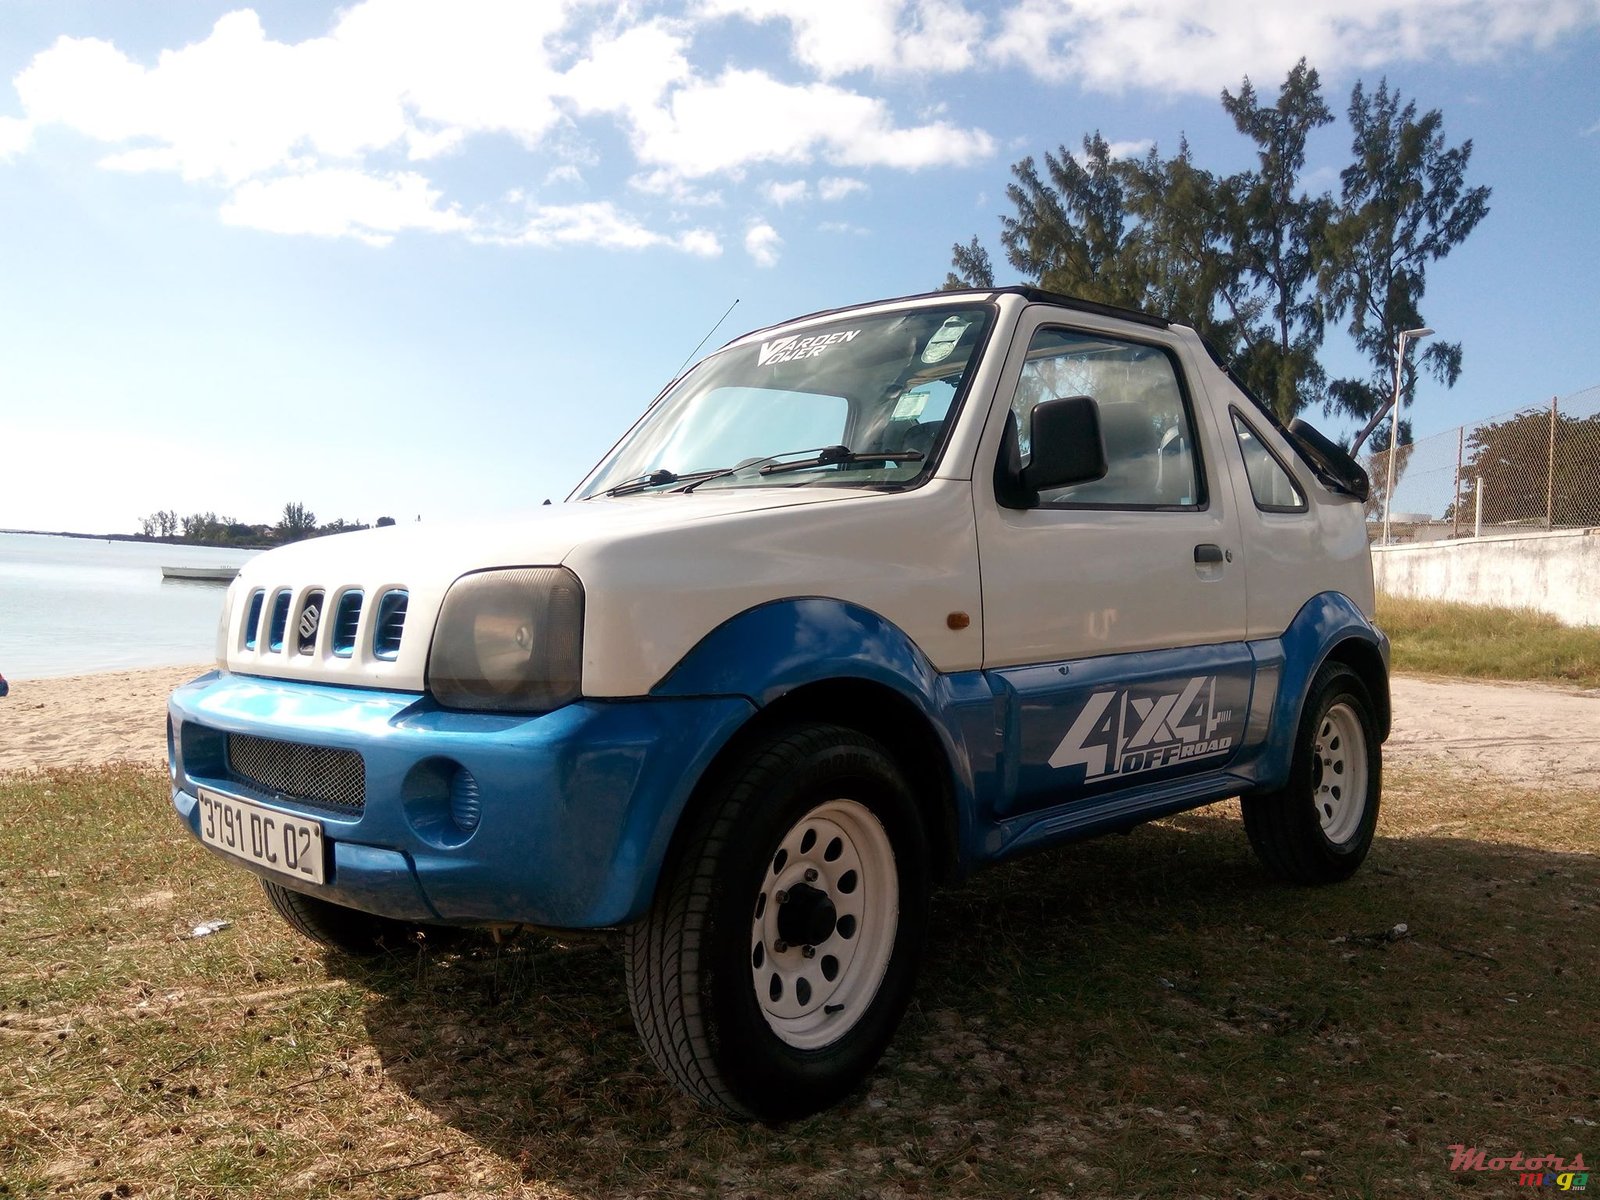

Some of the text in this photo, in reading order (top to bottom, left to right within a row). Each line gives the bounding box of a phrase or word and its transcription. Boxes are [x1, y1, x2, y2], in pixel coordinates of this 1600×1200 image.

[204, 797, 313, 876] 3791 DC 02
